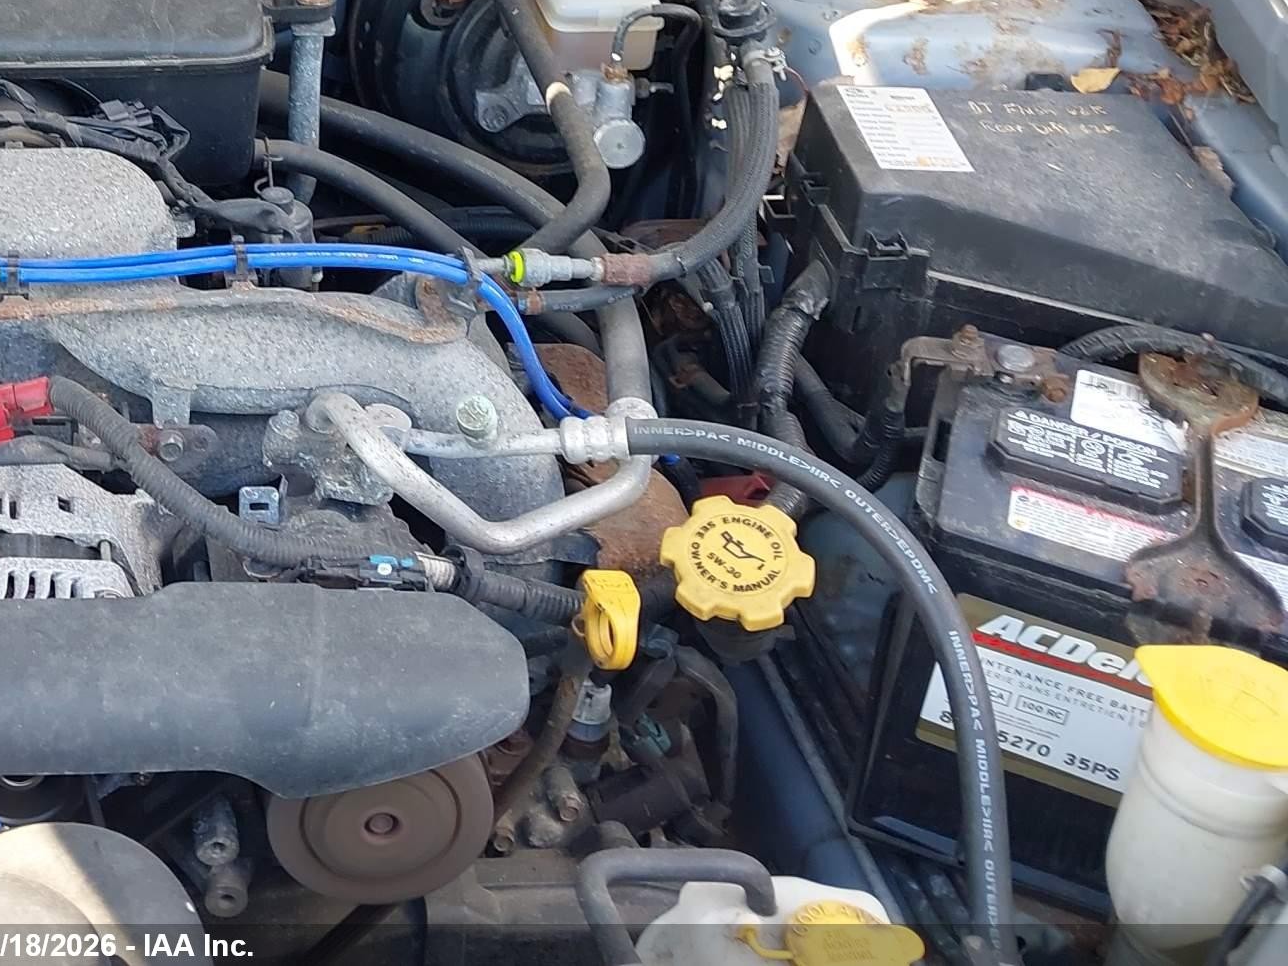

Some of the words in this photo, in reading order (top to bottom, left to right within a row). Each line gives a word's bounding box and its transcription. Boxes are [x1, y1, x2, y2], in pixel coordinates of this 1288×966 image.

[1028, 413, 1088, 437] DANGER
[1102, 434, 1157, 456] POISON
[694, 520, 717, 540] SEE
[722, 516, 774, 540] ENGINE
[770, 541, 784, 561] OIL
[690, 541, 729, 590] OWNER'S
[705, 551, 743, 580] 5W-30
[732, 568, 782, 593] MANUAL
[981, 656, 1063, 691] NTENANCE
[1068, 684, 1104, 704] FREE
[1109, 697, 1151, 721] BATT
[1019, 680, 1051, 698] SANS
[1021, 701, 1045, 716] 100
[1047, 707, 1065, 722] RC
[1063, 752, 1122, 782] 35PS
